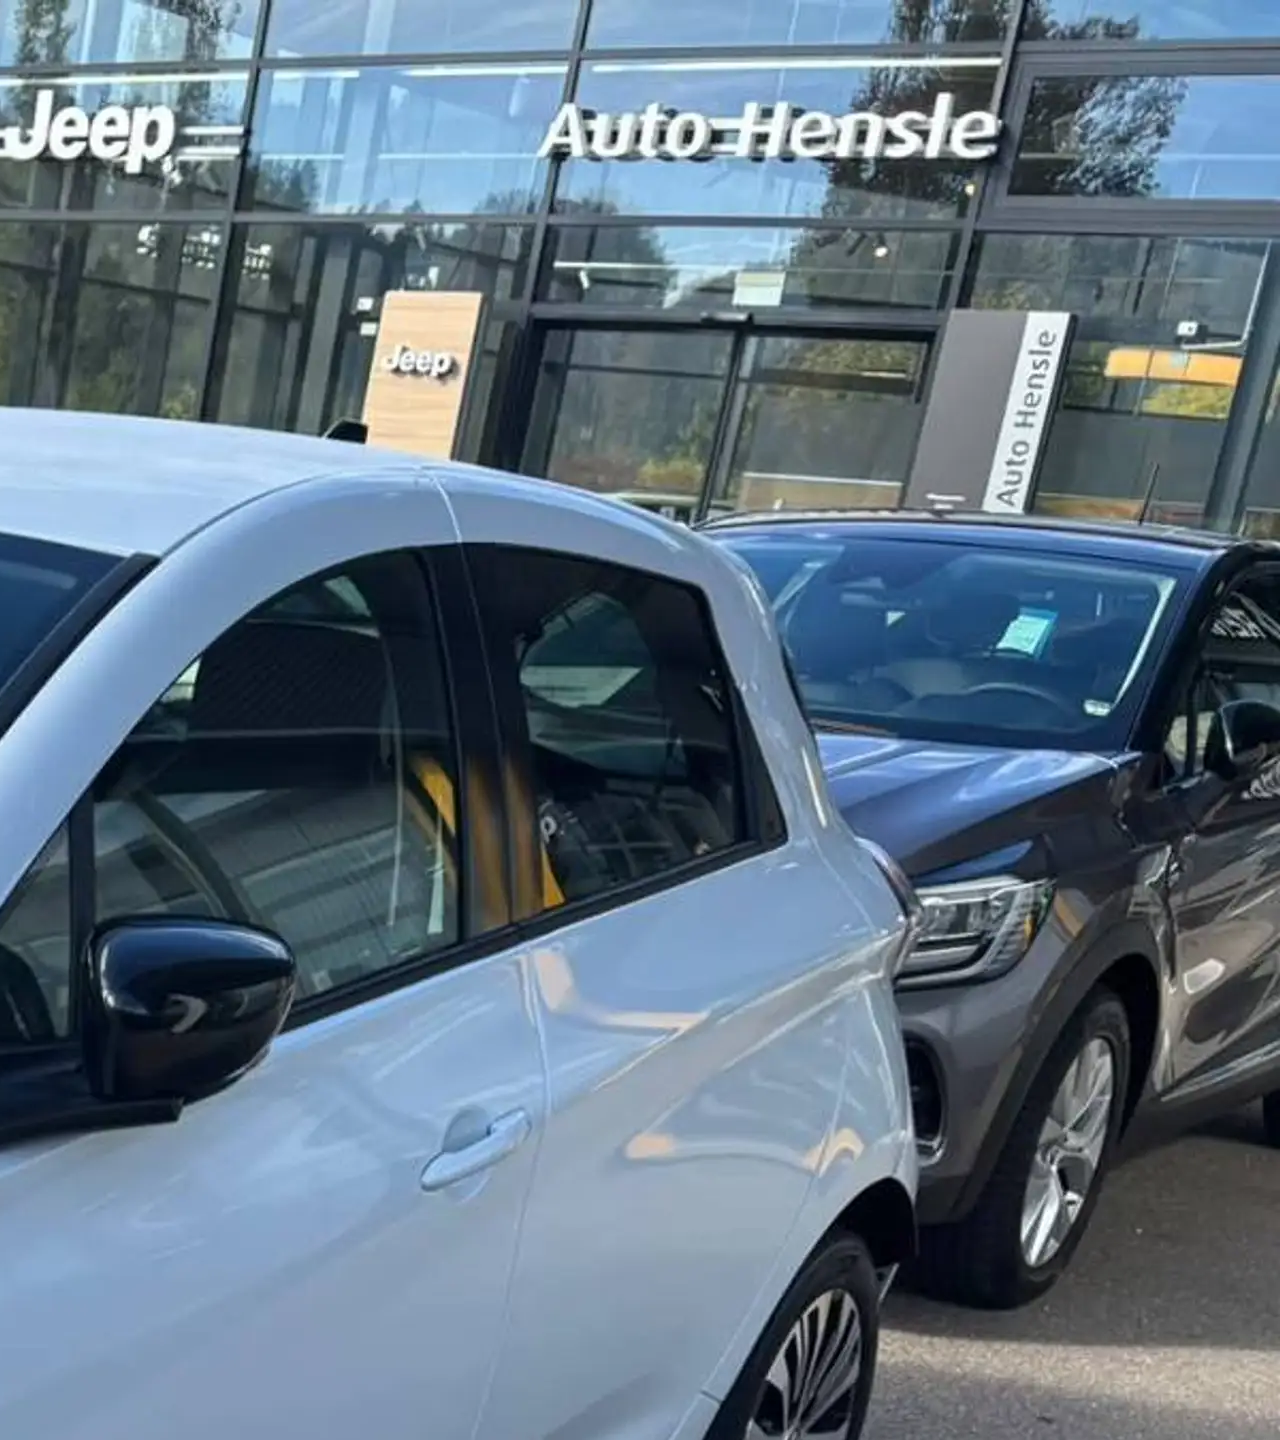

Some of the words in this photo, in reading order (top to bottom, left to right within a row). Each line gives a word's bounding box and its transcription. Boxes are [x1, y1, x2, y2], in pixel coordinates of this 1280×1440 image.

[4, 89, 175, 173] Jeep
[539, 101, 714, 160] Auto
[736, 92, 1001, 161] Hensle
[383, 344, 452, 376] Jeep
[996, 440, 1031, 508] Auto
[1014, 330, 1057, 429] Hensle
